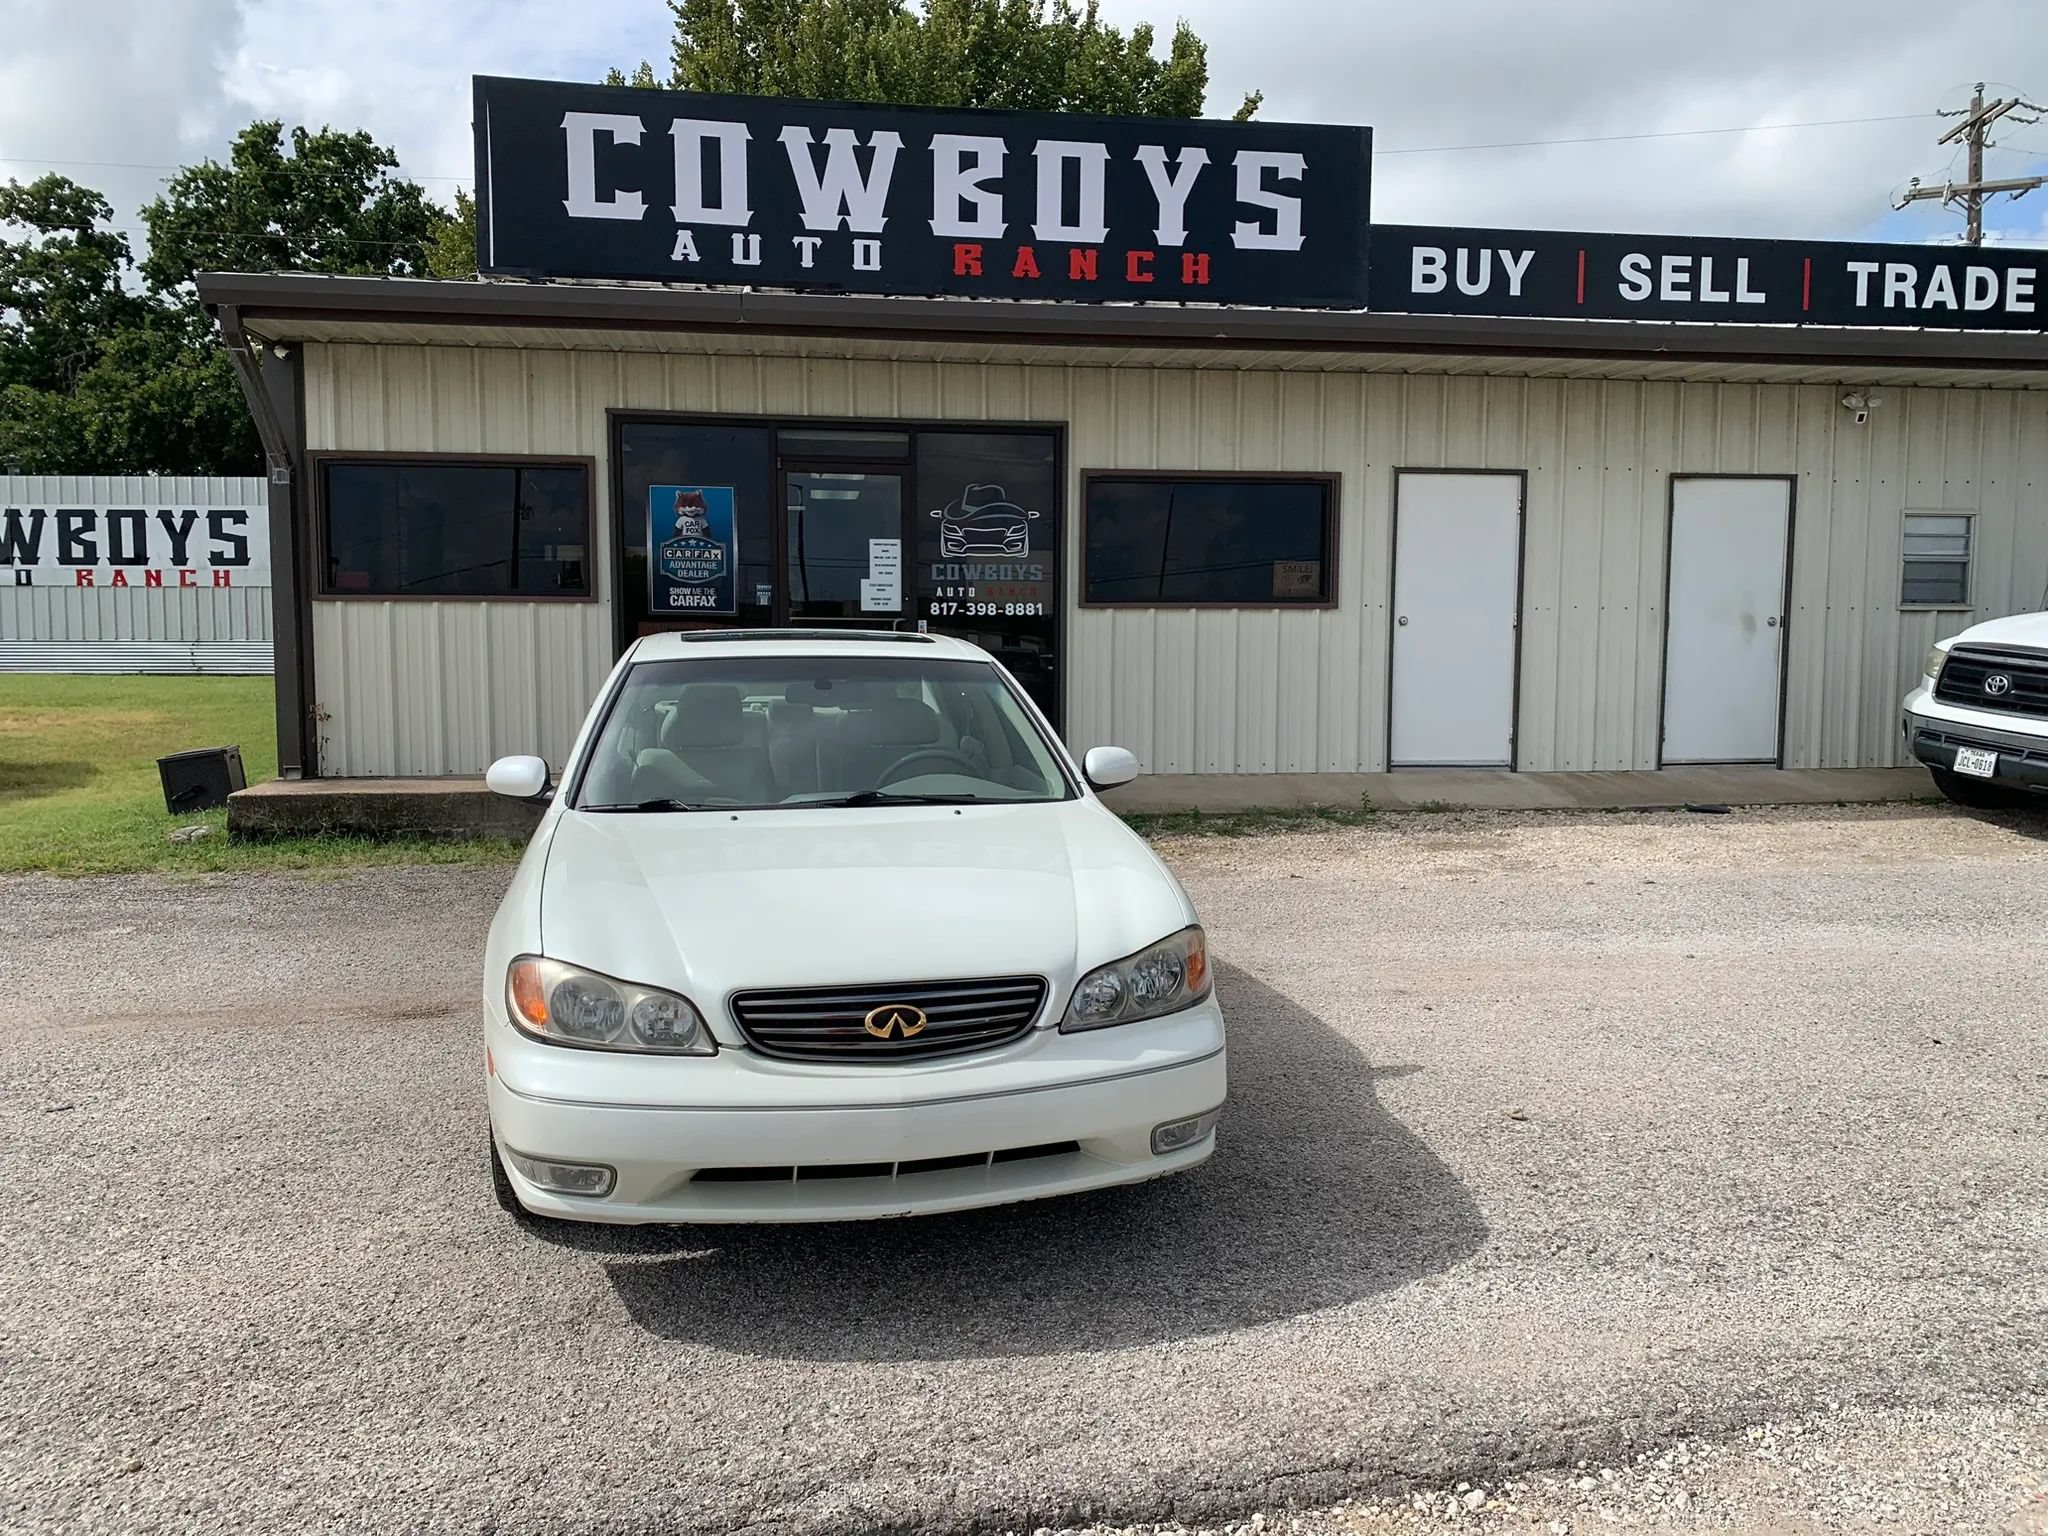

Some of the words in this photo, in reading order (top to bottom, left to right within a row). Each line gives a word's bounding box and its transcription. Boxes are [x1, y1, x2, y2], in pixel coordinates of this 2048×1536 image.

[560, 111, 1308, 251] COWBOYS
[670, 229, 882, 271] AUTO
[952, 243, 1211, 285] RANCH
[1411, 246, 1536, 296] BUY
[1618, 252, 1766, 304] SELL
[1846, 261, 2037, 313] TRADE
[665, 550, 721, 560] CARFAX
[669, 561, 717, 569] ADVANTAGE
[75, 569, 231, 587] RANCH
[678, 570, 709, 578] DEALER
[931, 564, 1043, 581] COWBOYS
[669, 587, 691, 595] SHOW
[936, 587, 976, 597] AUTO
[670, 595, 716, 607] CARFAX
[930, 602, 1043, 616] 817-398-8881
